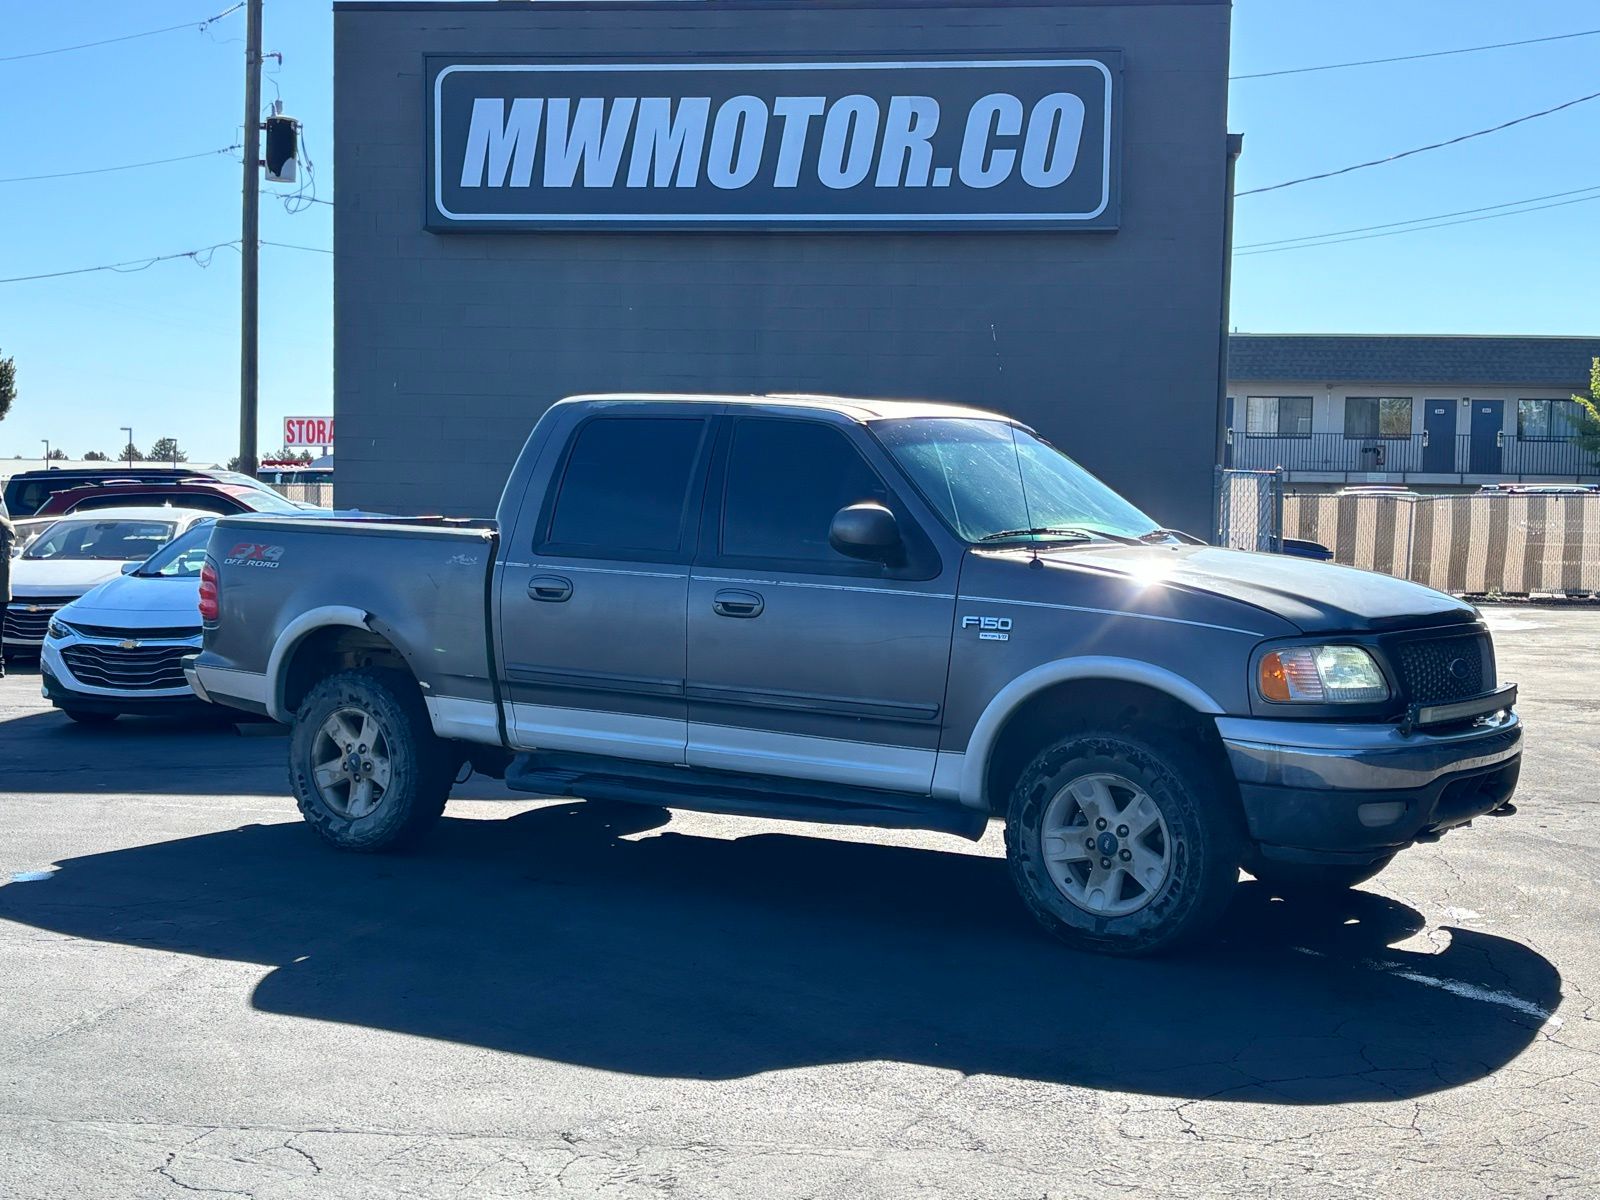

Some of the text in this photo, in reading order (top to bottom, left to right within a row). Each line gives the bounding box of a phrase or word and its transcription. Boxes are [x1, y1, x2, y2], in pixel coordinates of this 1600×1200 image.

[460, 92, 1085, 190] MWMOTOR.CO
[223, 558, 280, 568] OFF ROAD
[962, 616, 1012, 630] F150
